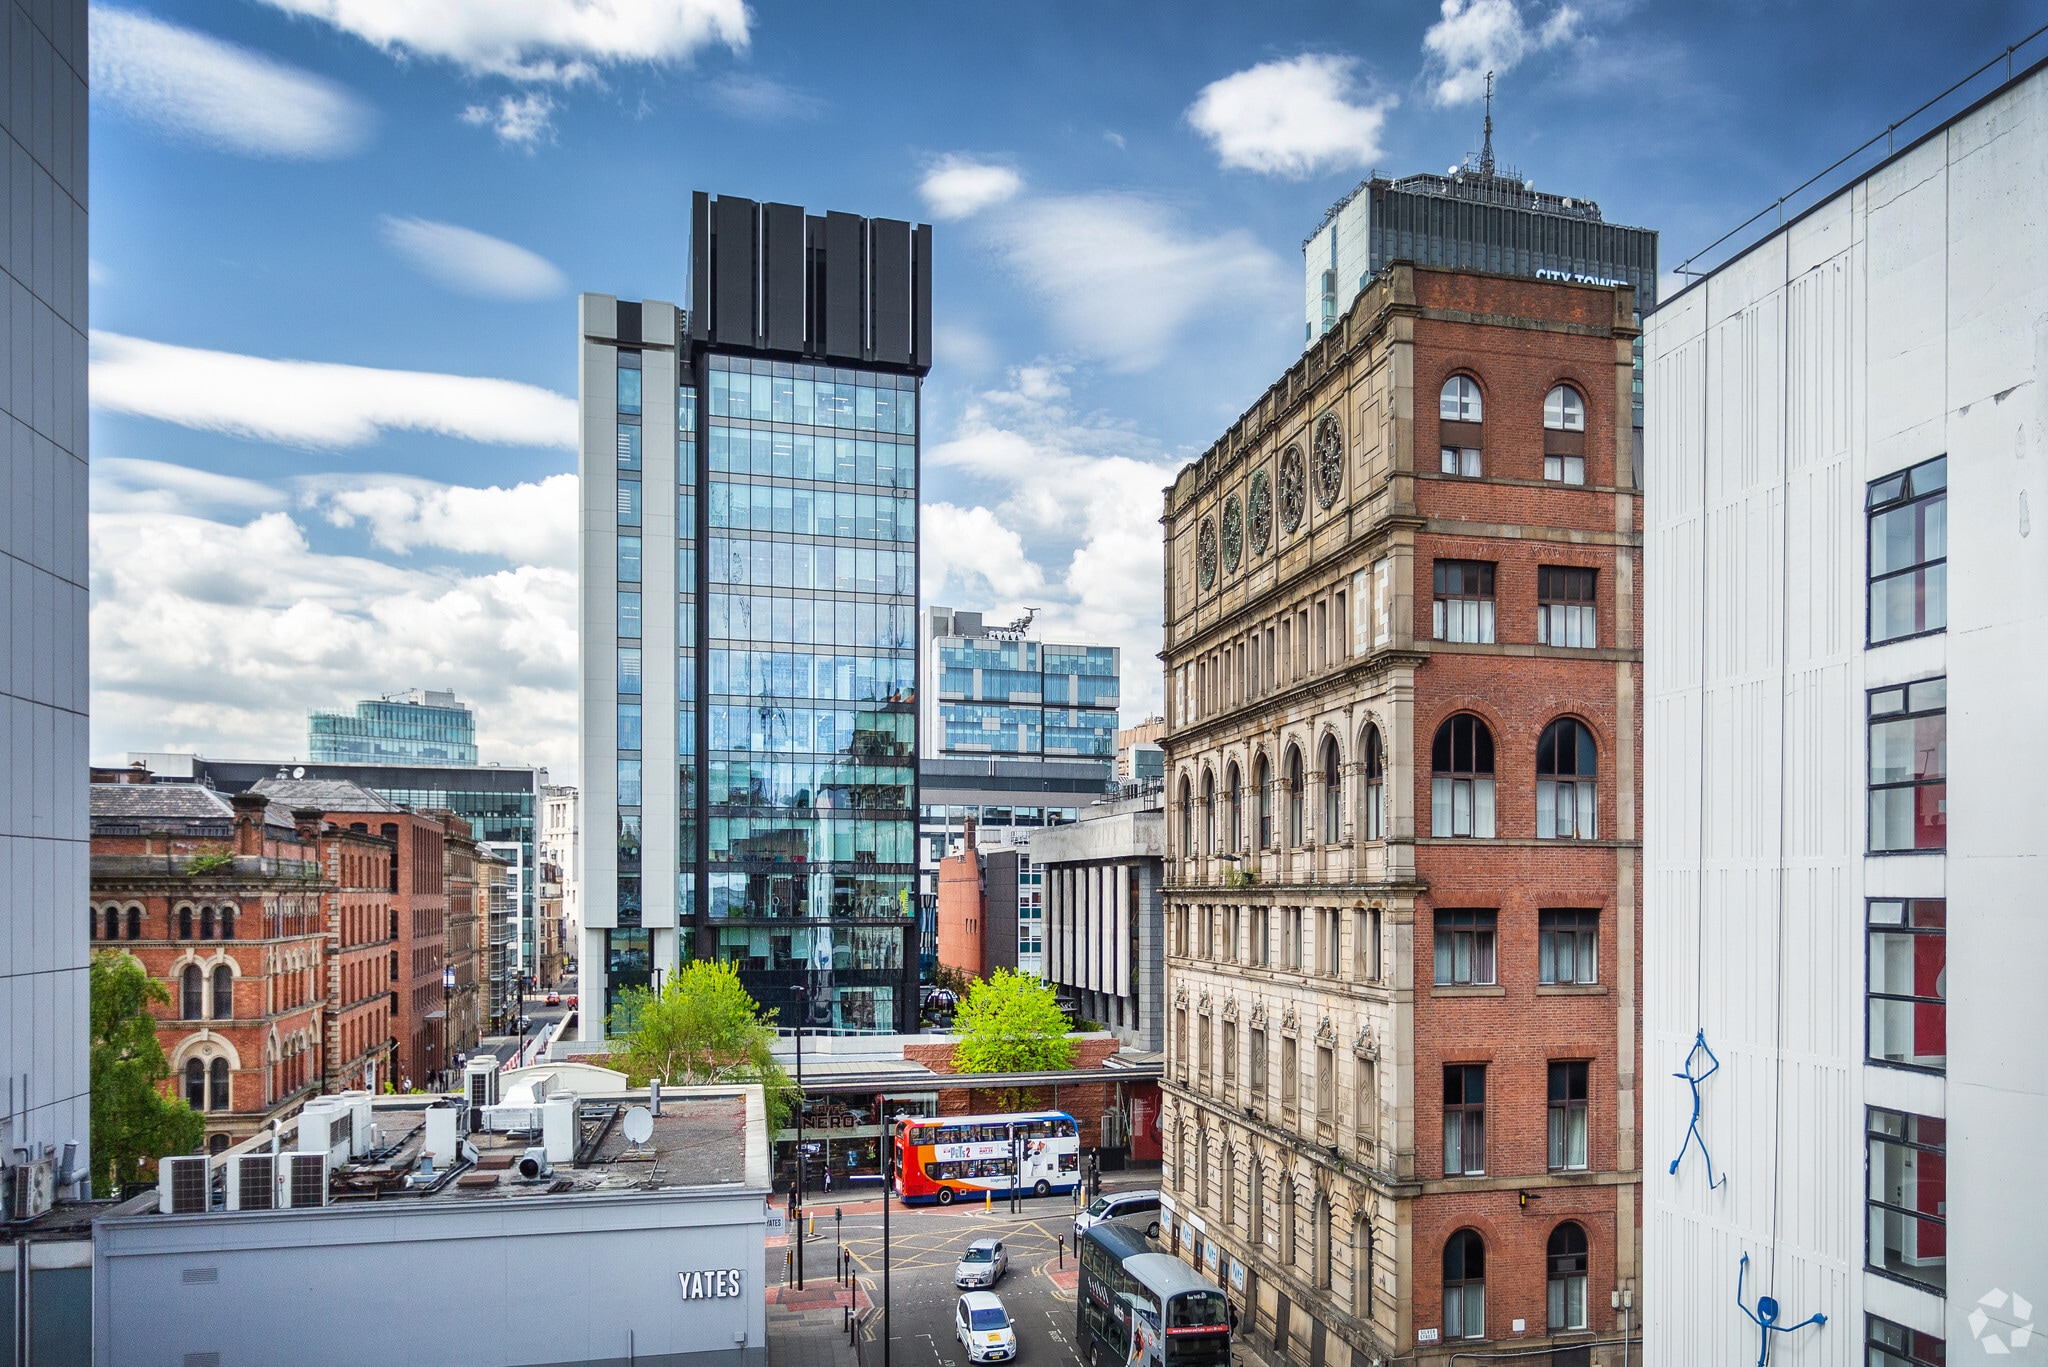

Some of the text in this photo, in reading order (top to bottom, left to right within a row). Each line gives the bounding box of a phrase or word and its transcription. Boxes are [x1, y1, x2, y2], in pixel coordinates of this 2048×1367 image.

[802, 1114, 855, 1129] NERO
[766, 1219, 782, 1227] YATES
[678, 1268, 740, 1300] YATES
